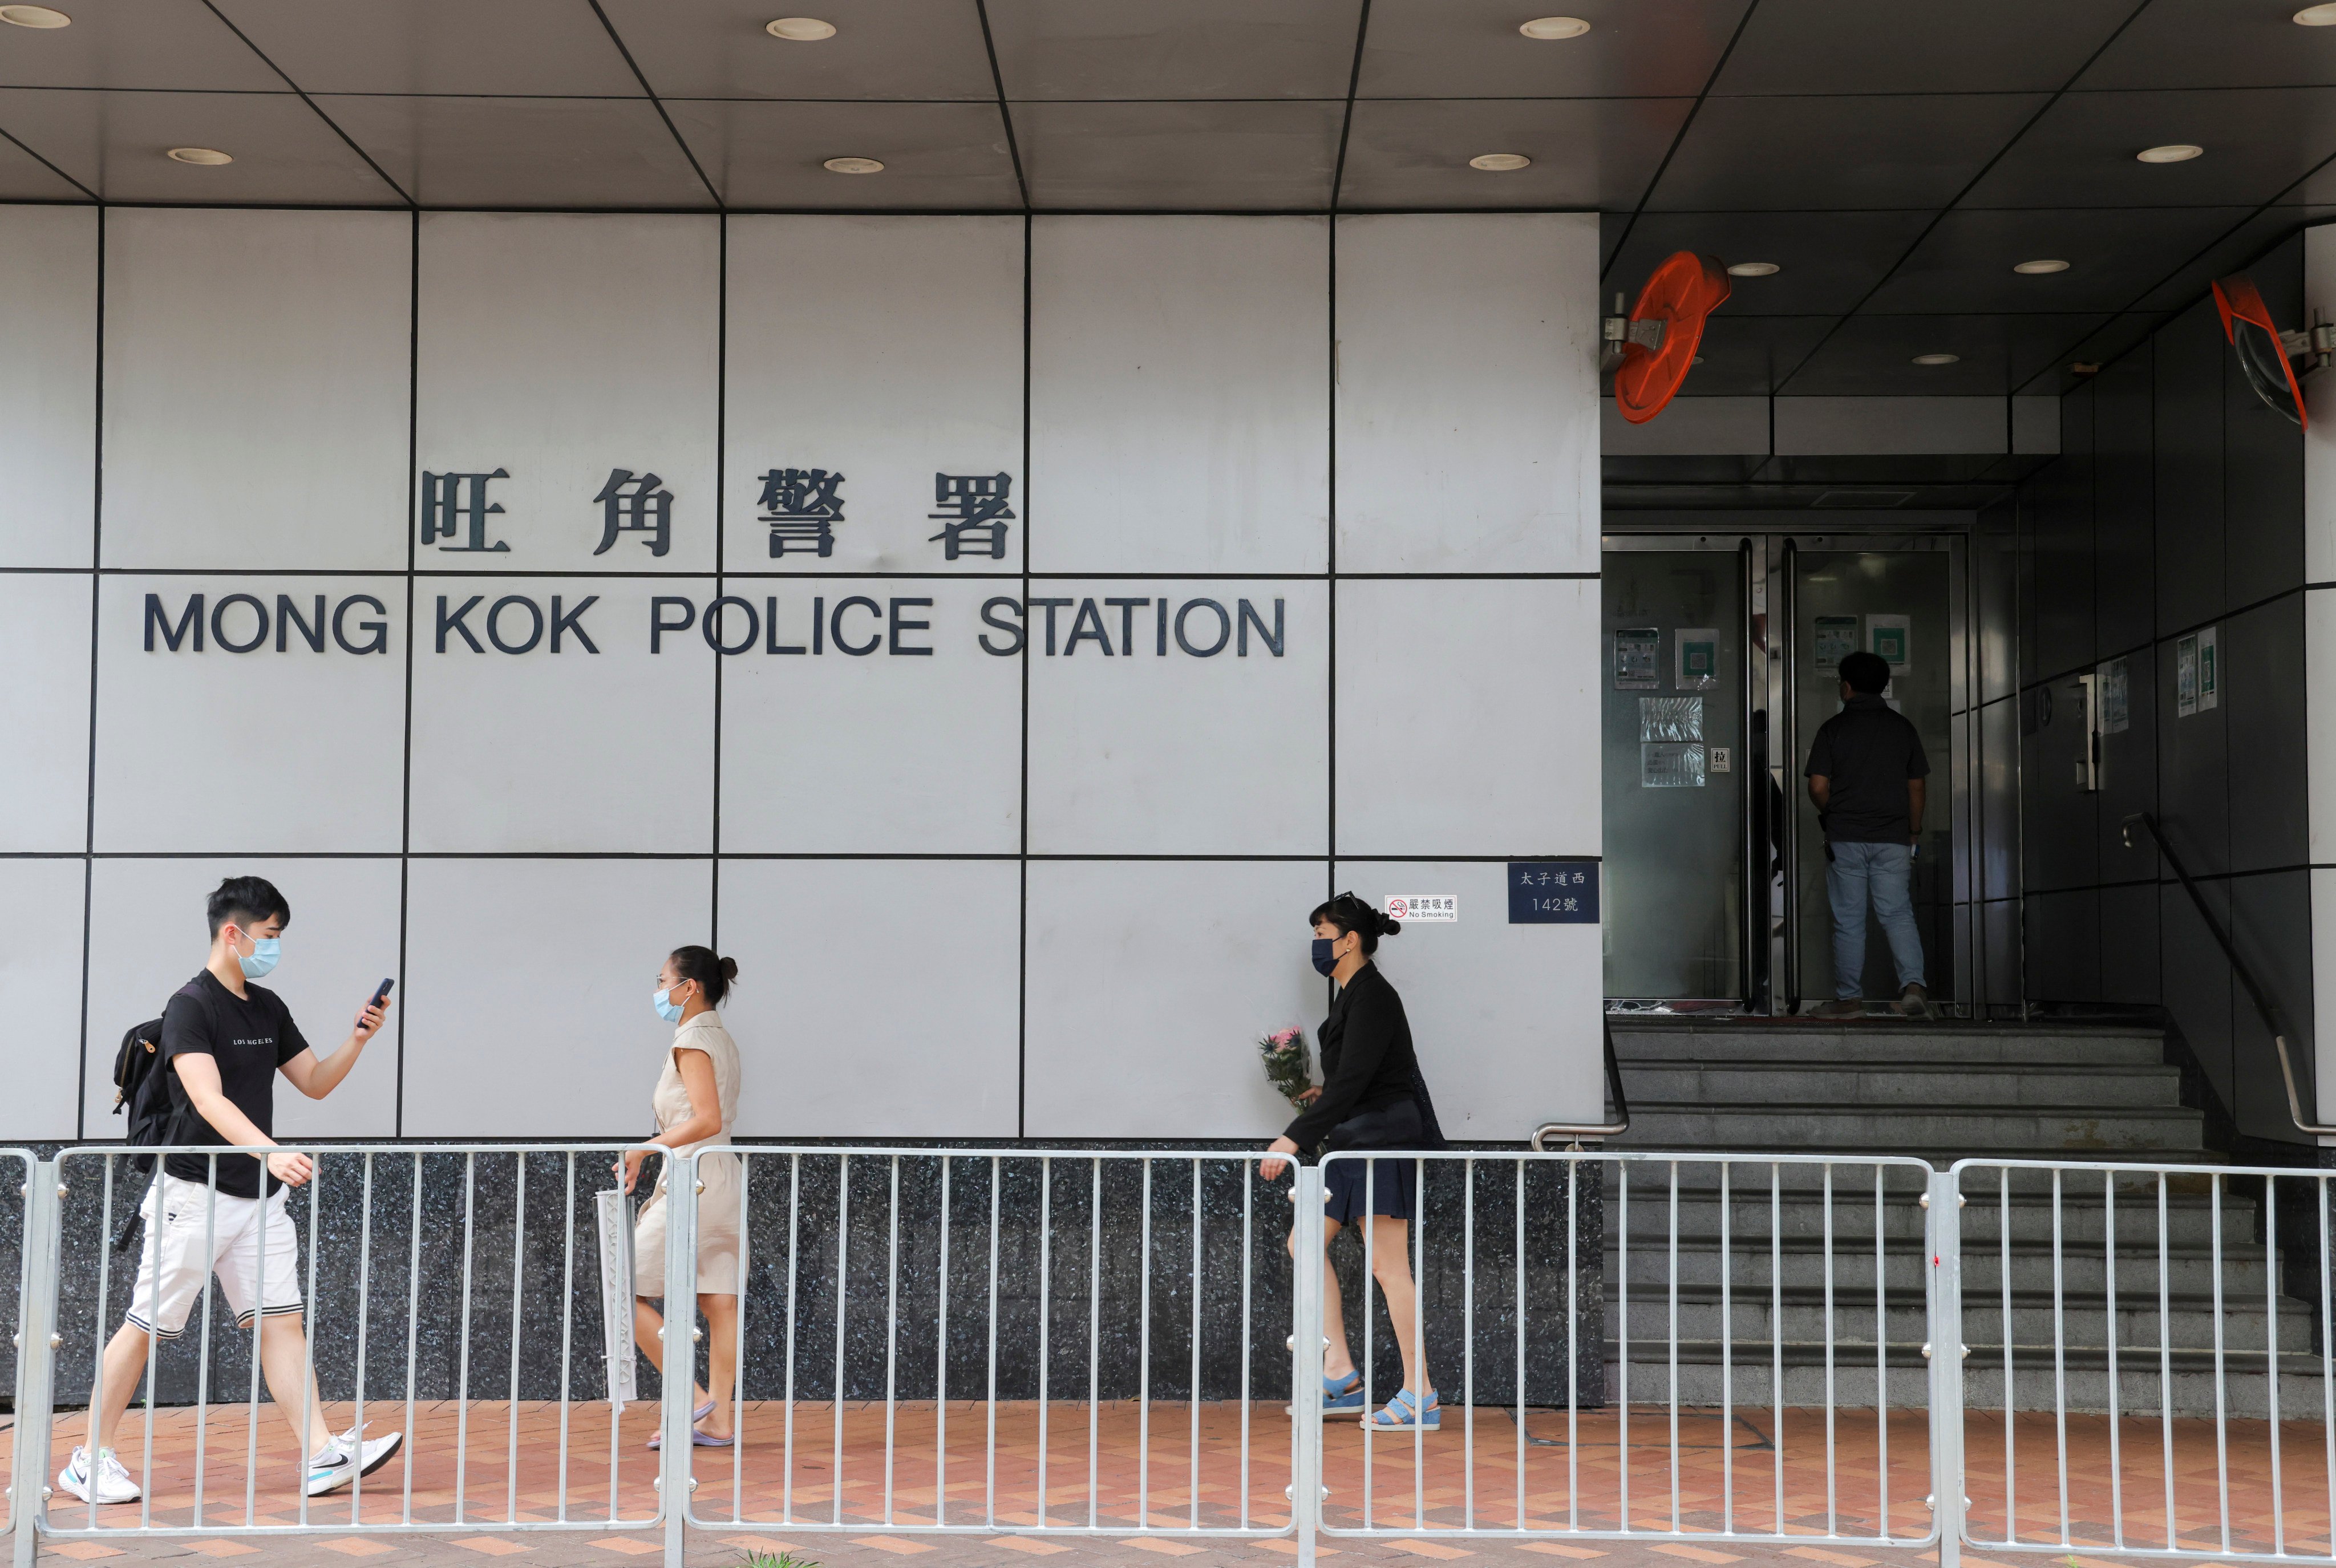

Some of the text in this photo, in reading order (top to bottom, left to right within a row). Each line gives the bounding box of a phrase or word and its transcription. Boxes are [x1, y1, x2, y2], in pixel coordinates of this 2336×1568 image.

[421, 467, 1016, 561] 旺角警署
[144, 593, 1285, 657] MONG KOK POLICE STATION
[1714, 751, 1726, 763] 拉
[1520, 872, 1585, 886] 太子道西
[1408, 898, 1454, 910] 嚴禁吸煙
[1532, 897, 1578, 912] 142號
